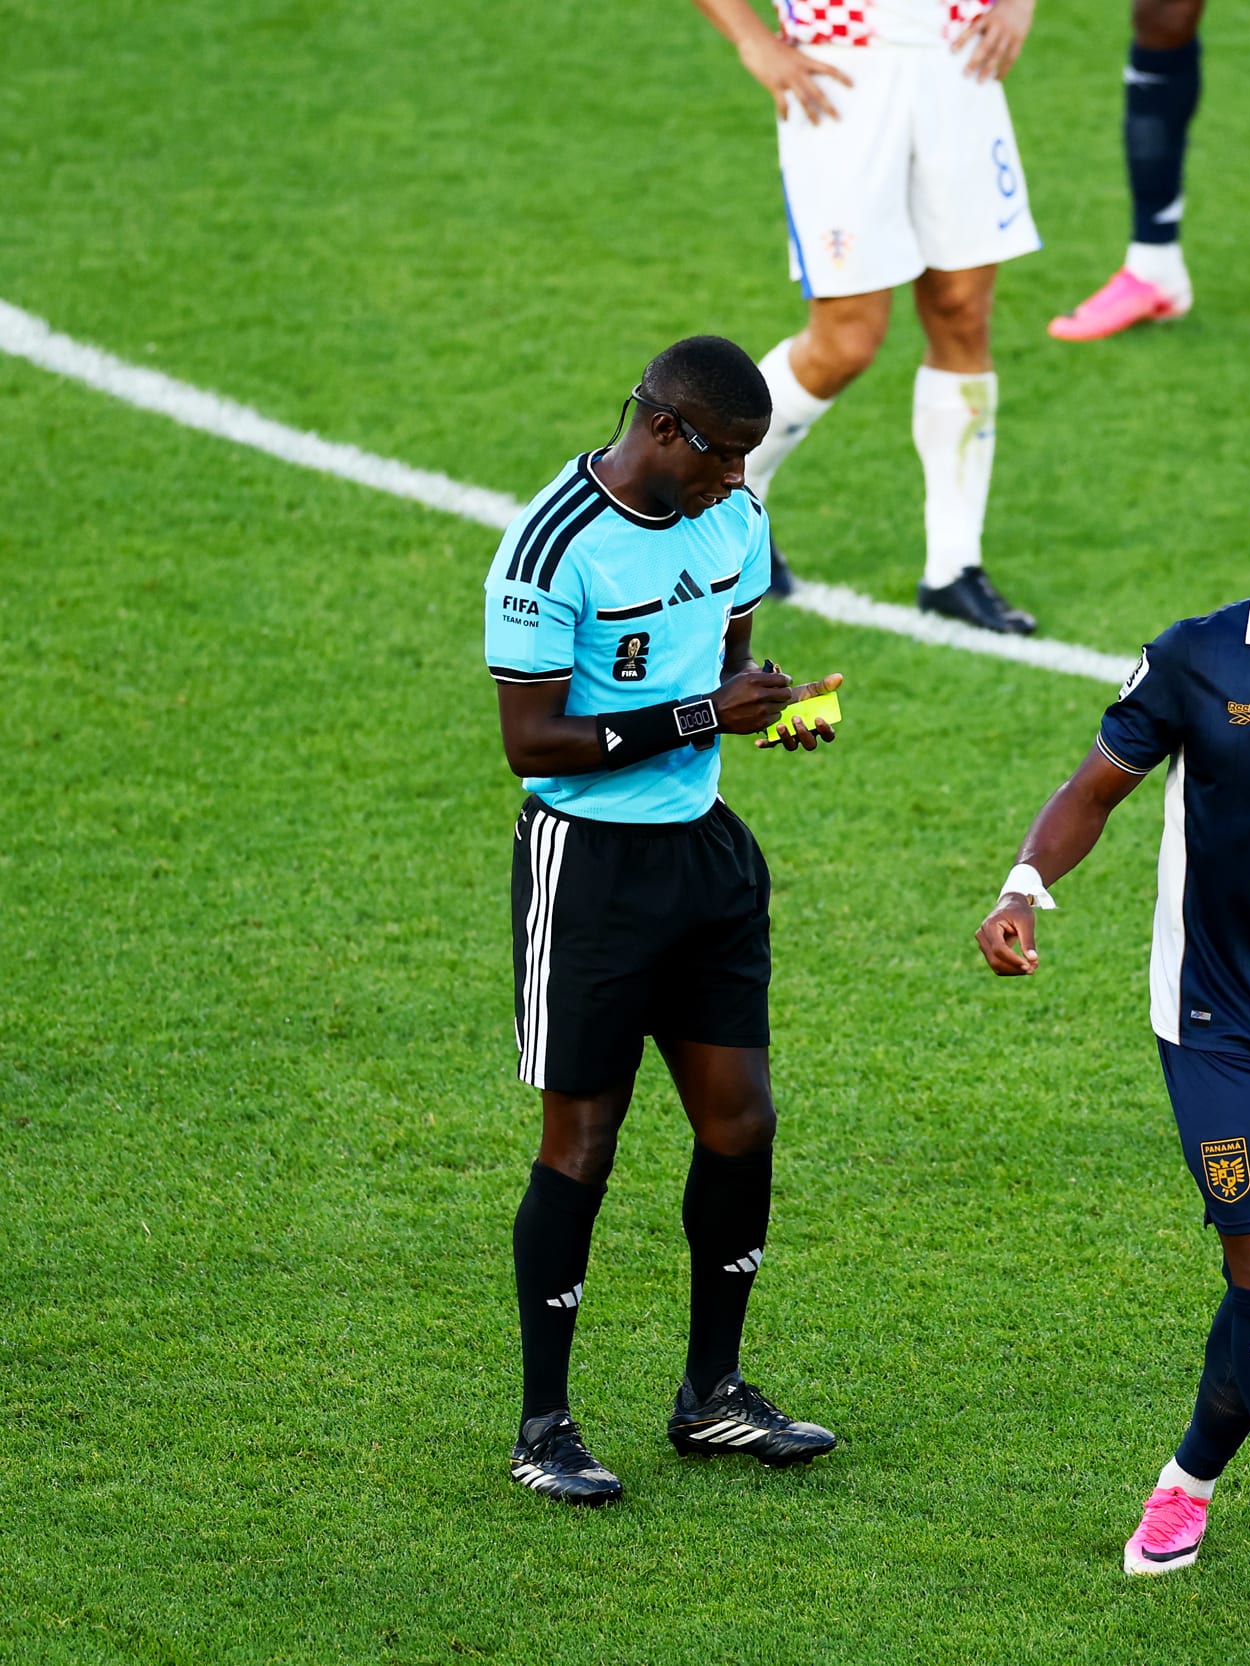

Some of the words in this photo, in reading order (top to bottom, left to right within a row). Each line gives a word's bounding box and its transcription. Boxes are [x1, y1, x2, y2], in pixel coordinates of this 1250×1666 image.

[992, 138, 1017, 198] 8
[503, 595, 540, 615] FIFA
[503, 614, 522, 625] TEAM
[523, 620, 540, 628] ONE
[621, 670, 638, 678] FIFA
[1205, 1140, 1242, 1153] PANAMÁ
